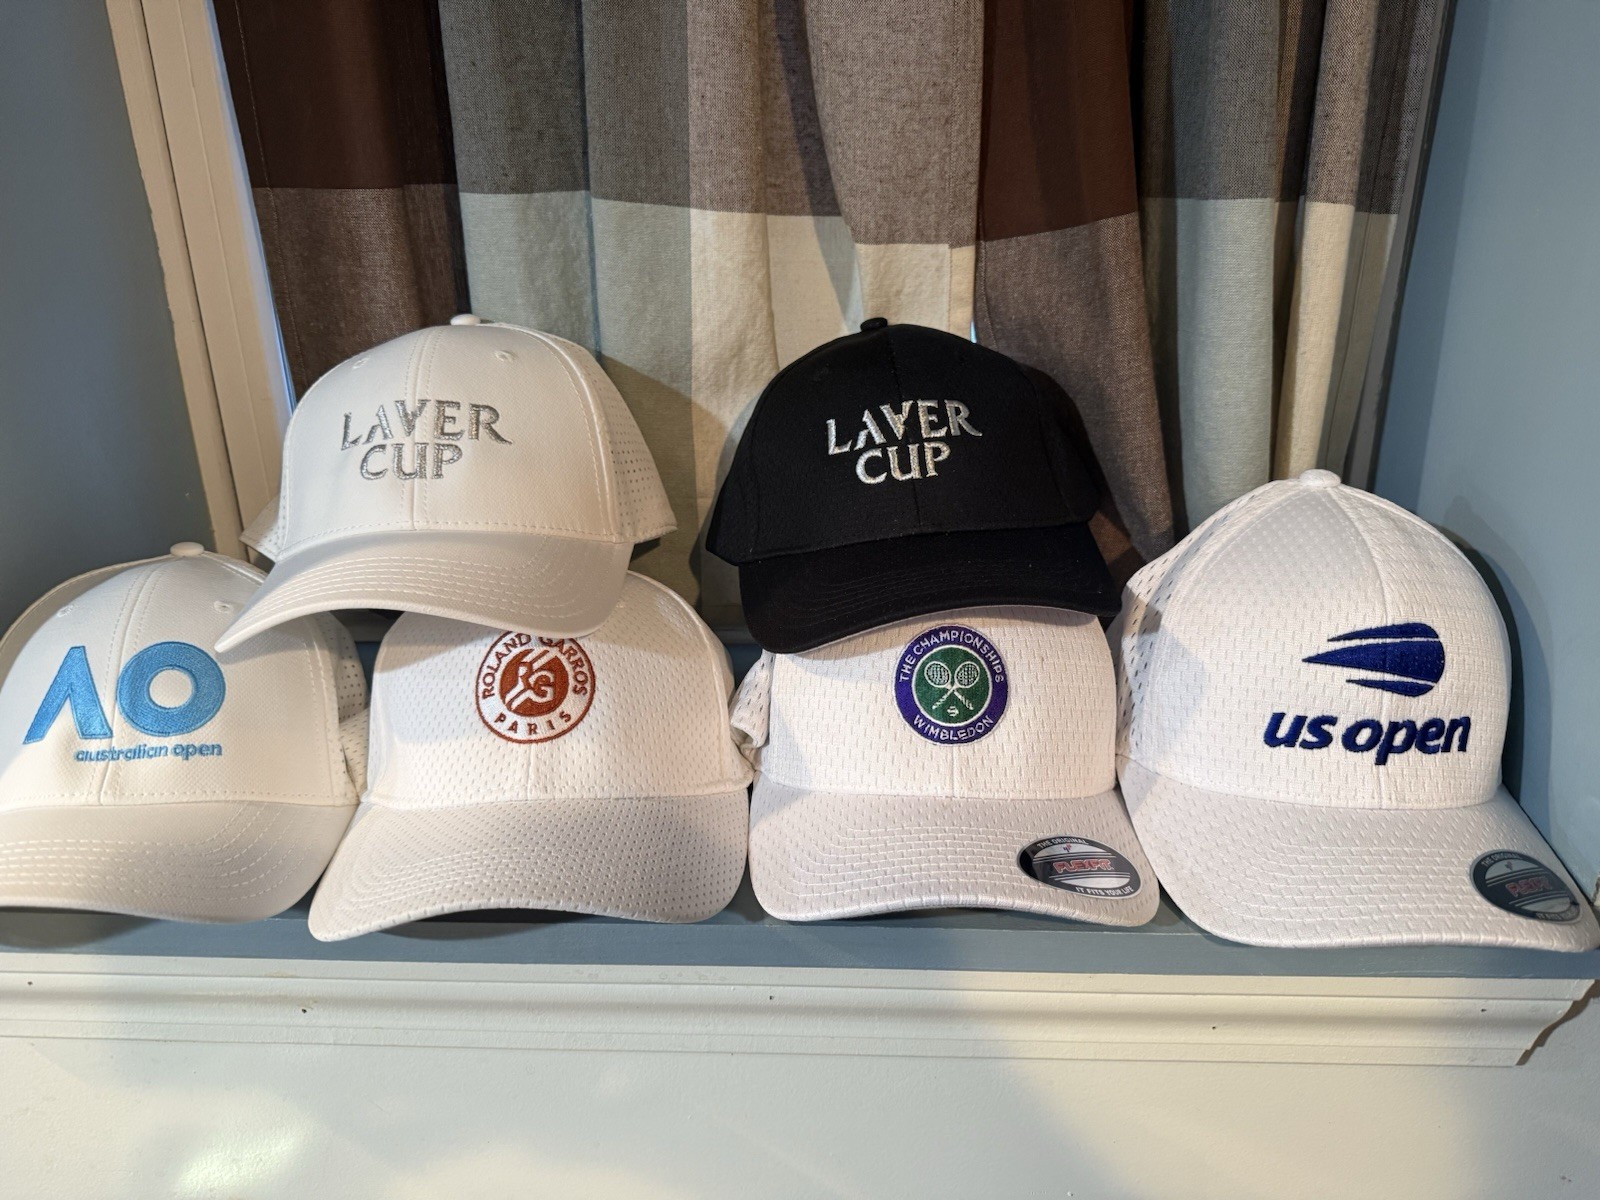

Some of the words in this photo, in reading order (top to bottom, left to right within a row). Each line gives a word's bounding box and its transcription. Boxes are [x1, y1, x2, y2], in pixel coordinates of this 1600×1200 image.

[341, 399, 513, 451] LAVER
[826, 399, 983, 456] LAVER
[360, 442, 463, 481] CUP
[855, 440, 951, 485] CUP
[482, 632, 532, 700] ROLAND
[899, 654, 917, 682] THE
[912, 629, 1005, 683] CHAMPIONSHIPS
[22, 640, 227, 745] AO
[494, 710, 572, 736] PARIS
[913, 714, 995, 741] WIMBLEDON
[1263, 712, 1338, 750] us
[1341, 716, 1472, 766] open
[75, 744, 169, 762] australian
[171, 742, 223, 761] open
[1037, 840, 1053, 849] THE
